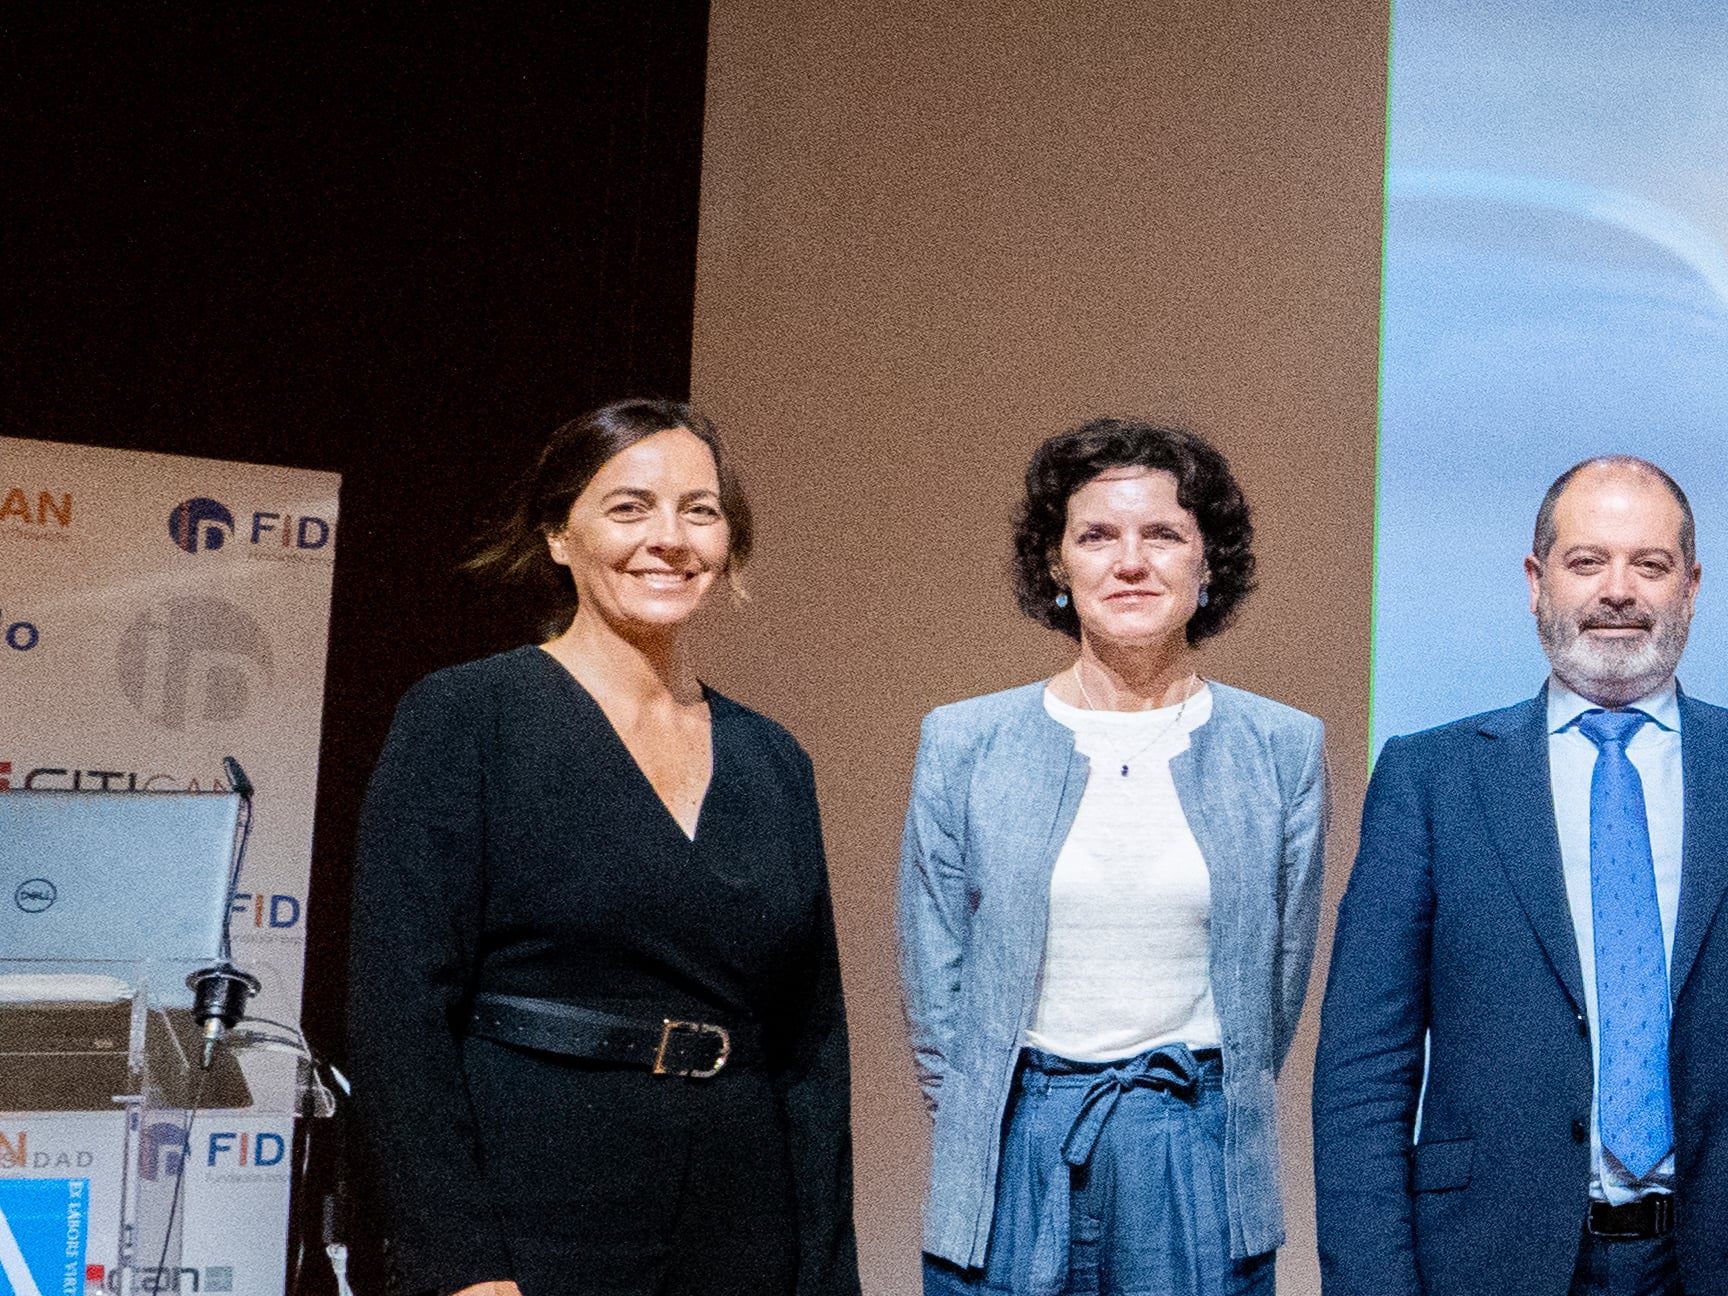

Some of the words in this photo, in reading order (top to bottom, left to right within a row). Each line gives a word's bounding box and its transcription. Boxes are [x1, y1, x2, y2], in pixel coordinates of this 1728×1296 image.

[251, 512, 330, 550] FID
[207, 1132, 285, 1167] FID
[65, 1203, 82, 1258] LABORE
